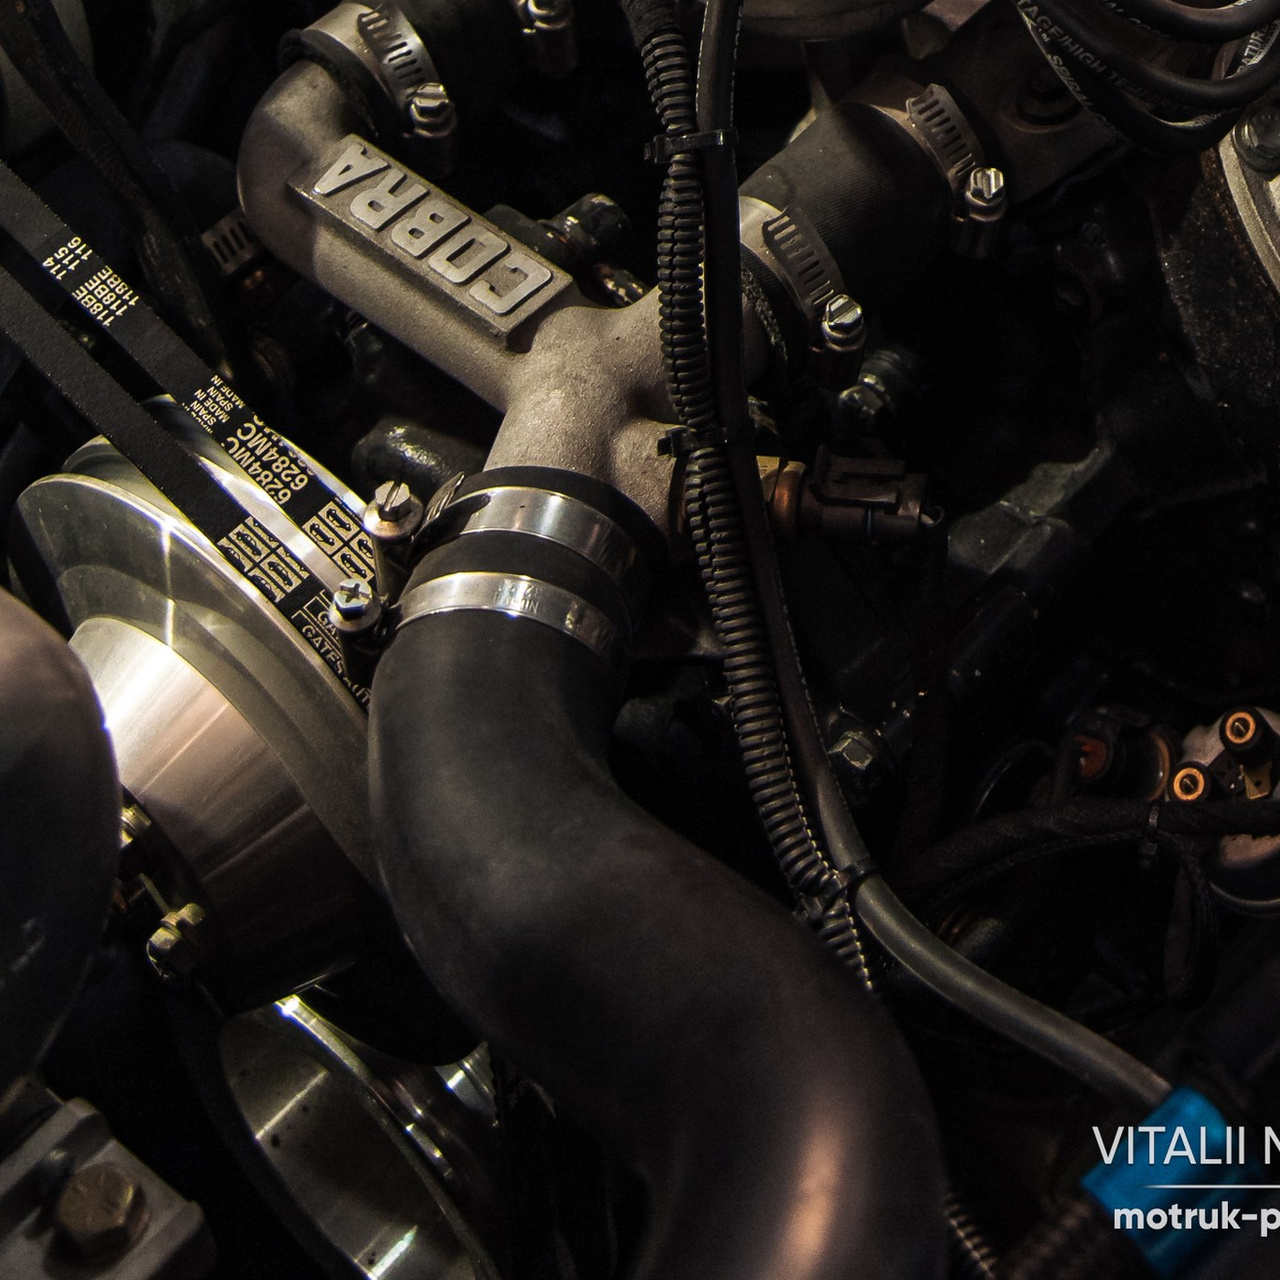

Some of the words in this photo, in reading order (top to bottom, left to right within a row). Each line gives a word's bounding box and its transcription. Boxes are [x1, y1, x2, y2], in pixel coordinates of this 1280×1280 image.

[312, 142, 553, 315] COBRA
[54, 247, 80, 271] 115
[67, 237, 93, 260] 116
[43, 257, 66, 280] 114
[84, 275, 127, 316] 118BE
[97, 265, 139, 306] 118BE
[72, 286, 114, 327] 118BE
[210, 374, 223, 386] IN
[194, 388, 207, 401] IN
[206, 386, 234, 412] SPAIN
[189, 400, 217, 426] SPAIN
[203, 398, 230, 424] MADE
[236, 422, 309, 491] 6284MC
